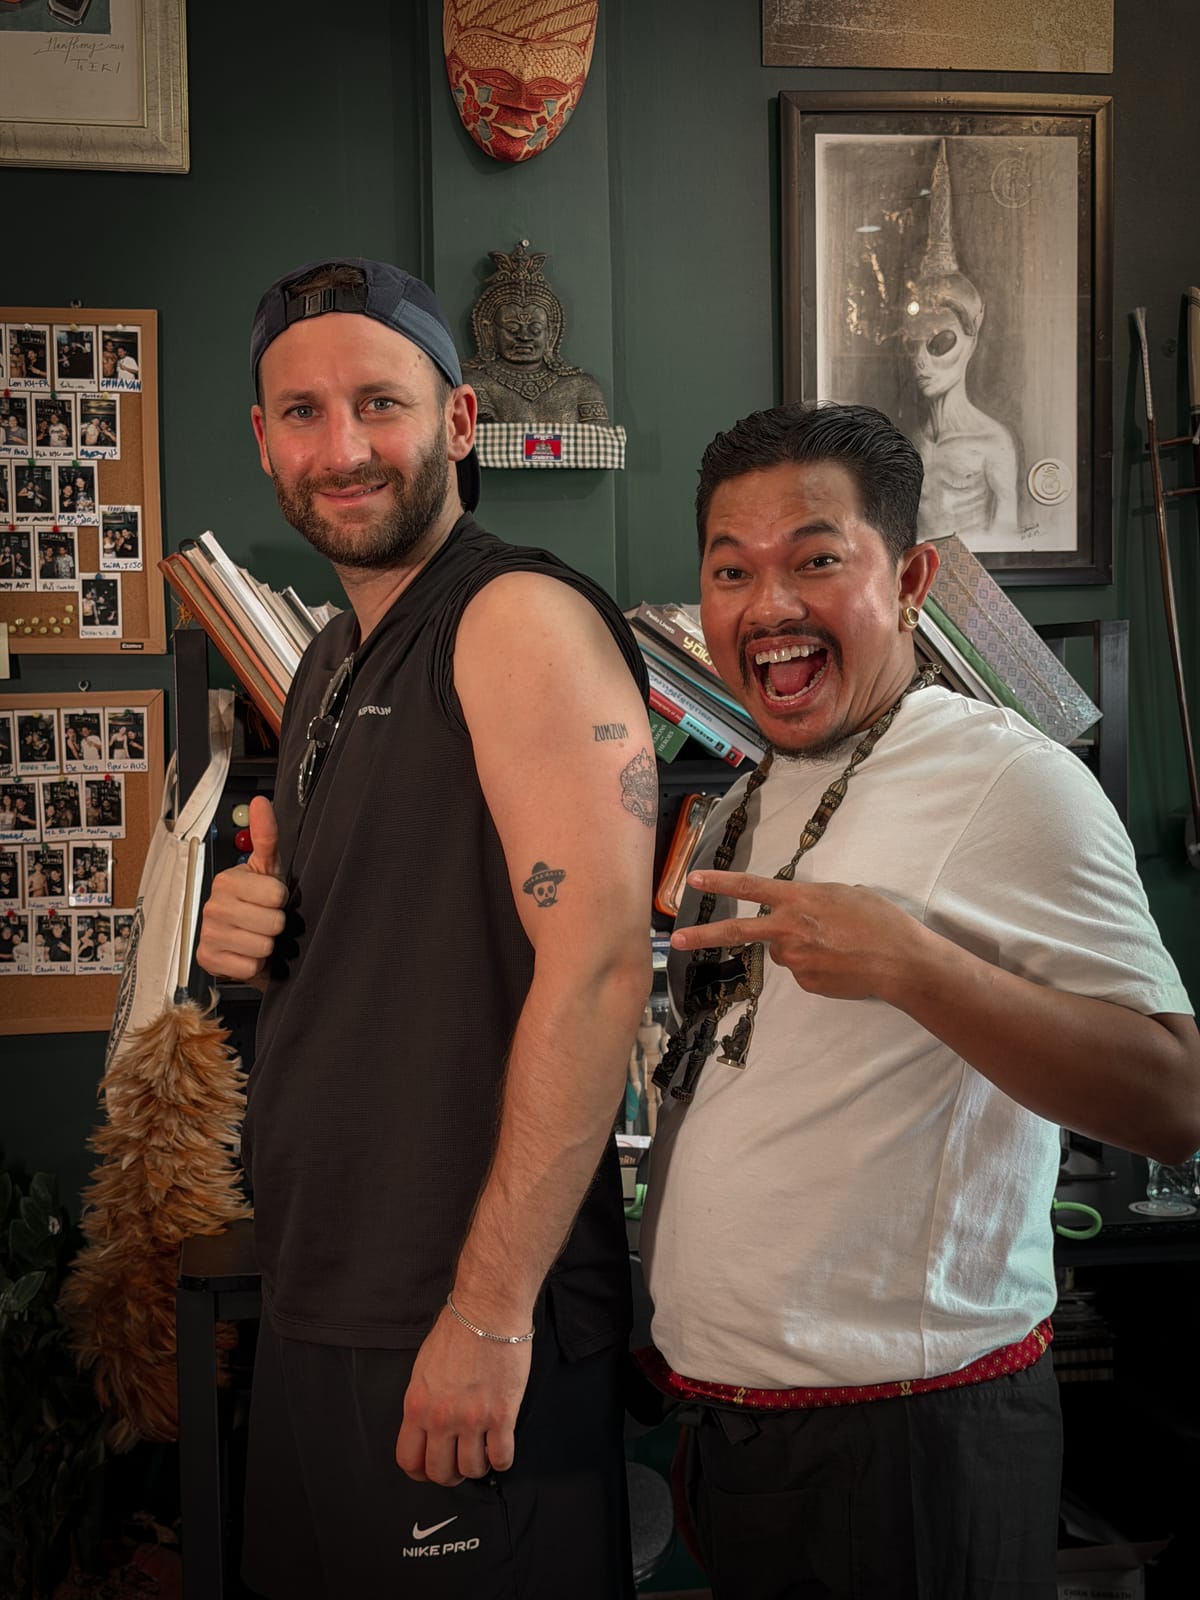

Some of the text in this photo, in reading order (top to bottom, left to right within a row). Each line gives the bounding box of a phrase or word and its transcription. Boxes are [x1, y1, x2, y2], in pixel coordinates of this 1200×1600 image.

[592, 723, 629, 743] ZUMZUM
[402, 1537, 480, 1558] NIKE PRO
